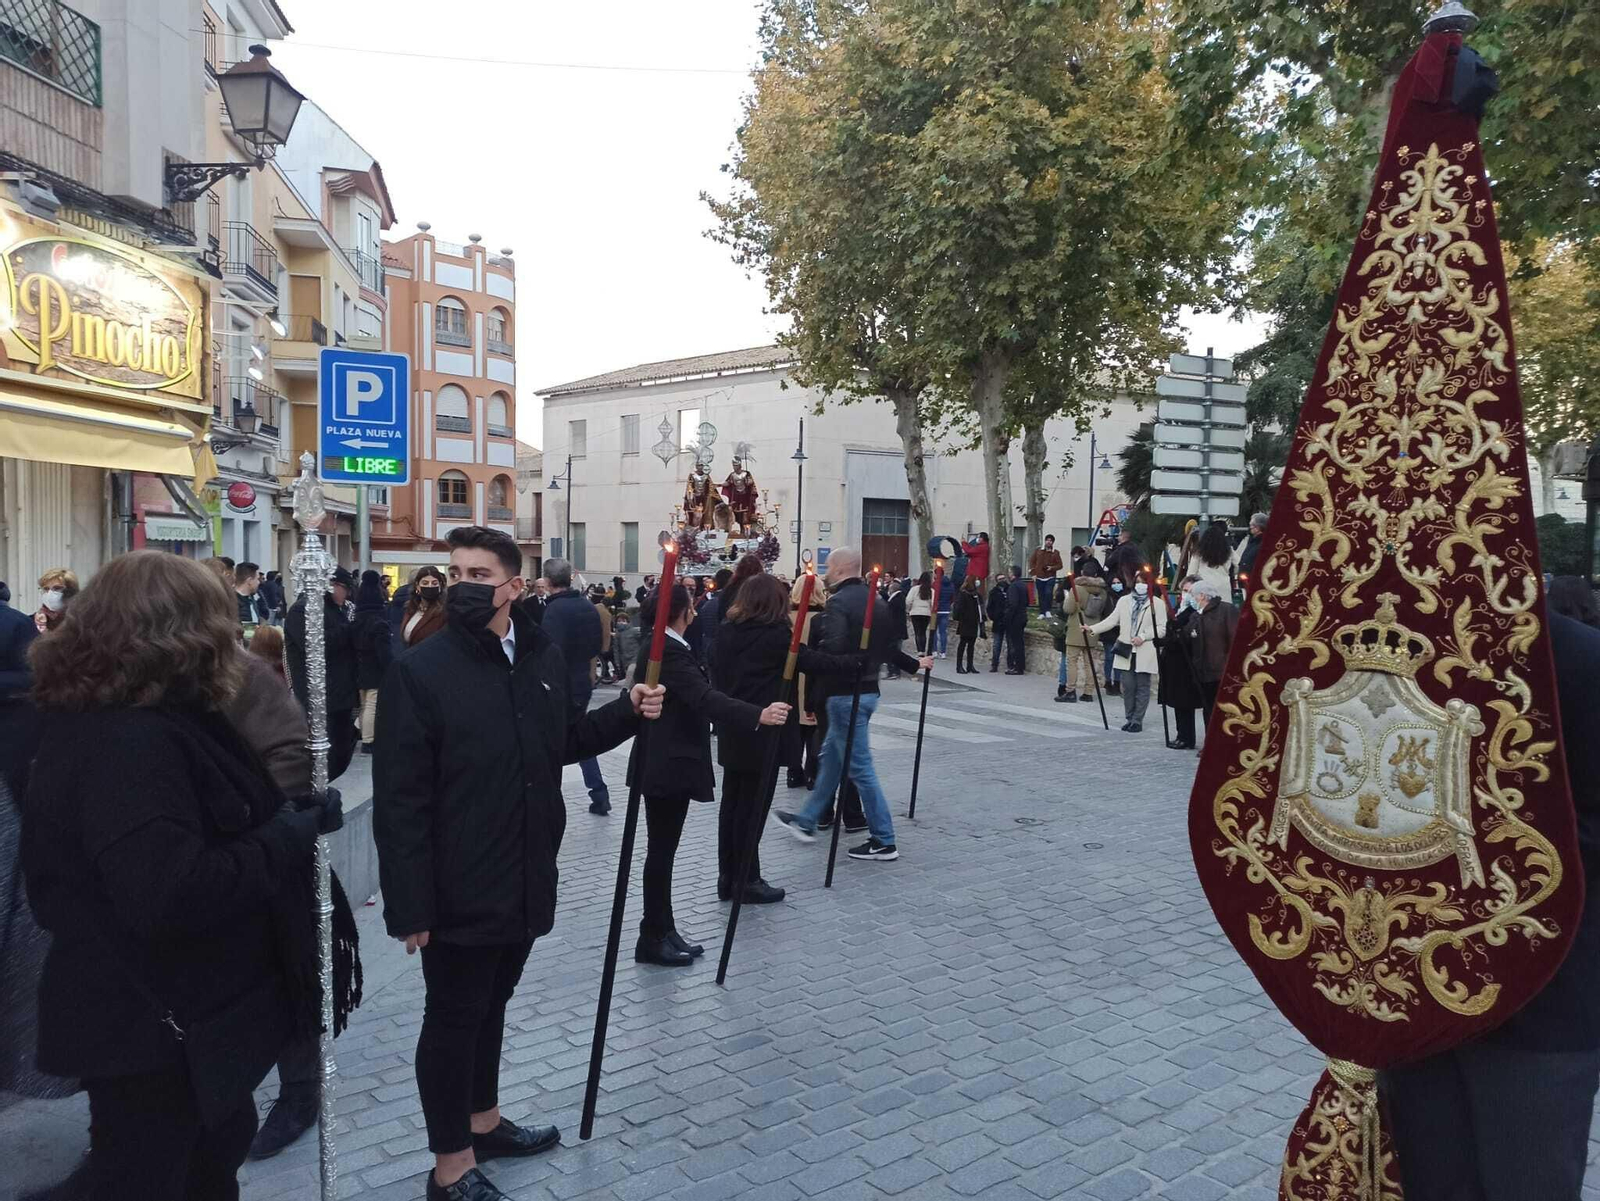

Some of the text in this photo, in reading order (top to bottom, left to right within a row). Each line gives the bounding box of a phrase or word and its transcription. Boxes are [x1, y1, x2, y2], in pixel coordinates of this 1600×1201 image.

[20, 272, 180, 379] Pinocho
[346, 370, 384, 416] P
[326, 426, 402, 439] PLAZA NUEVA
[343, 456, 397, 475] LIBRE
